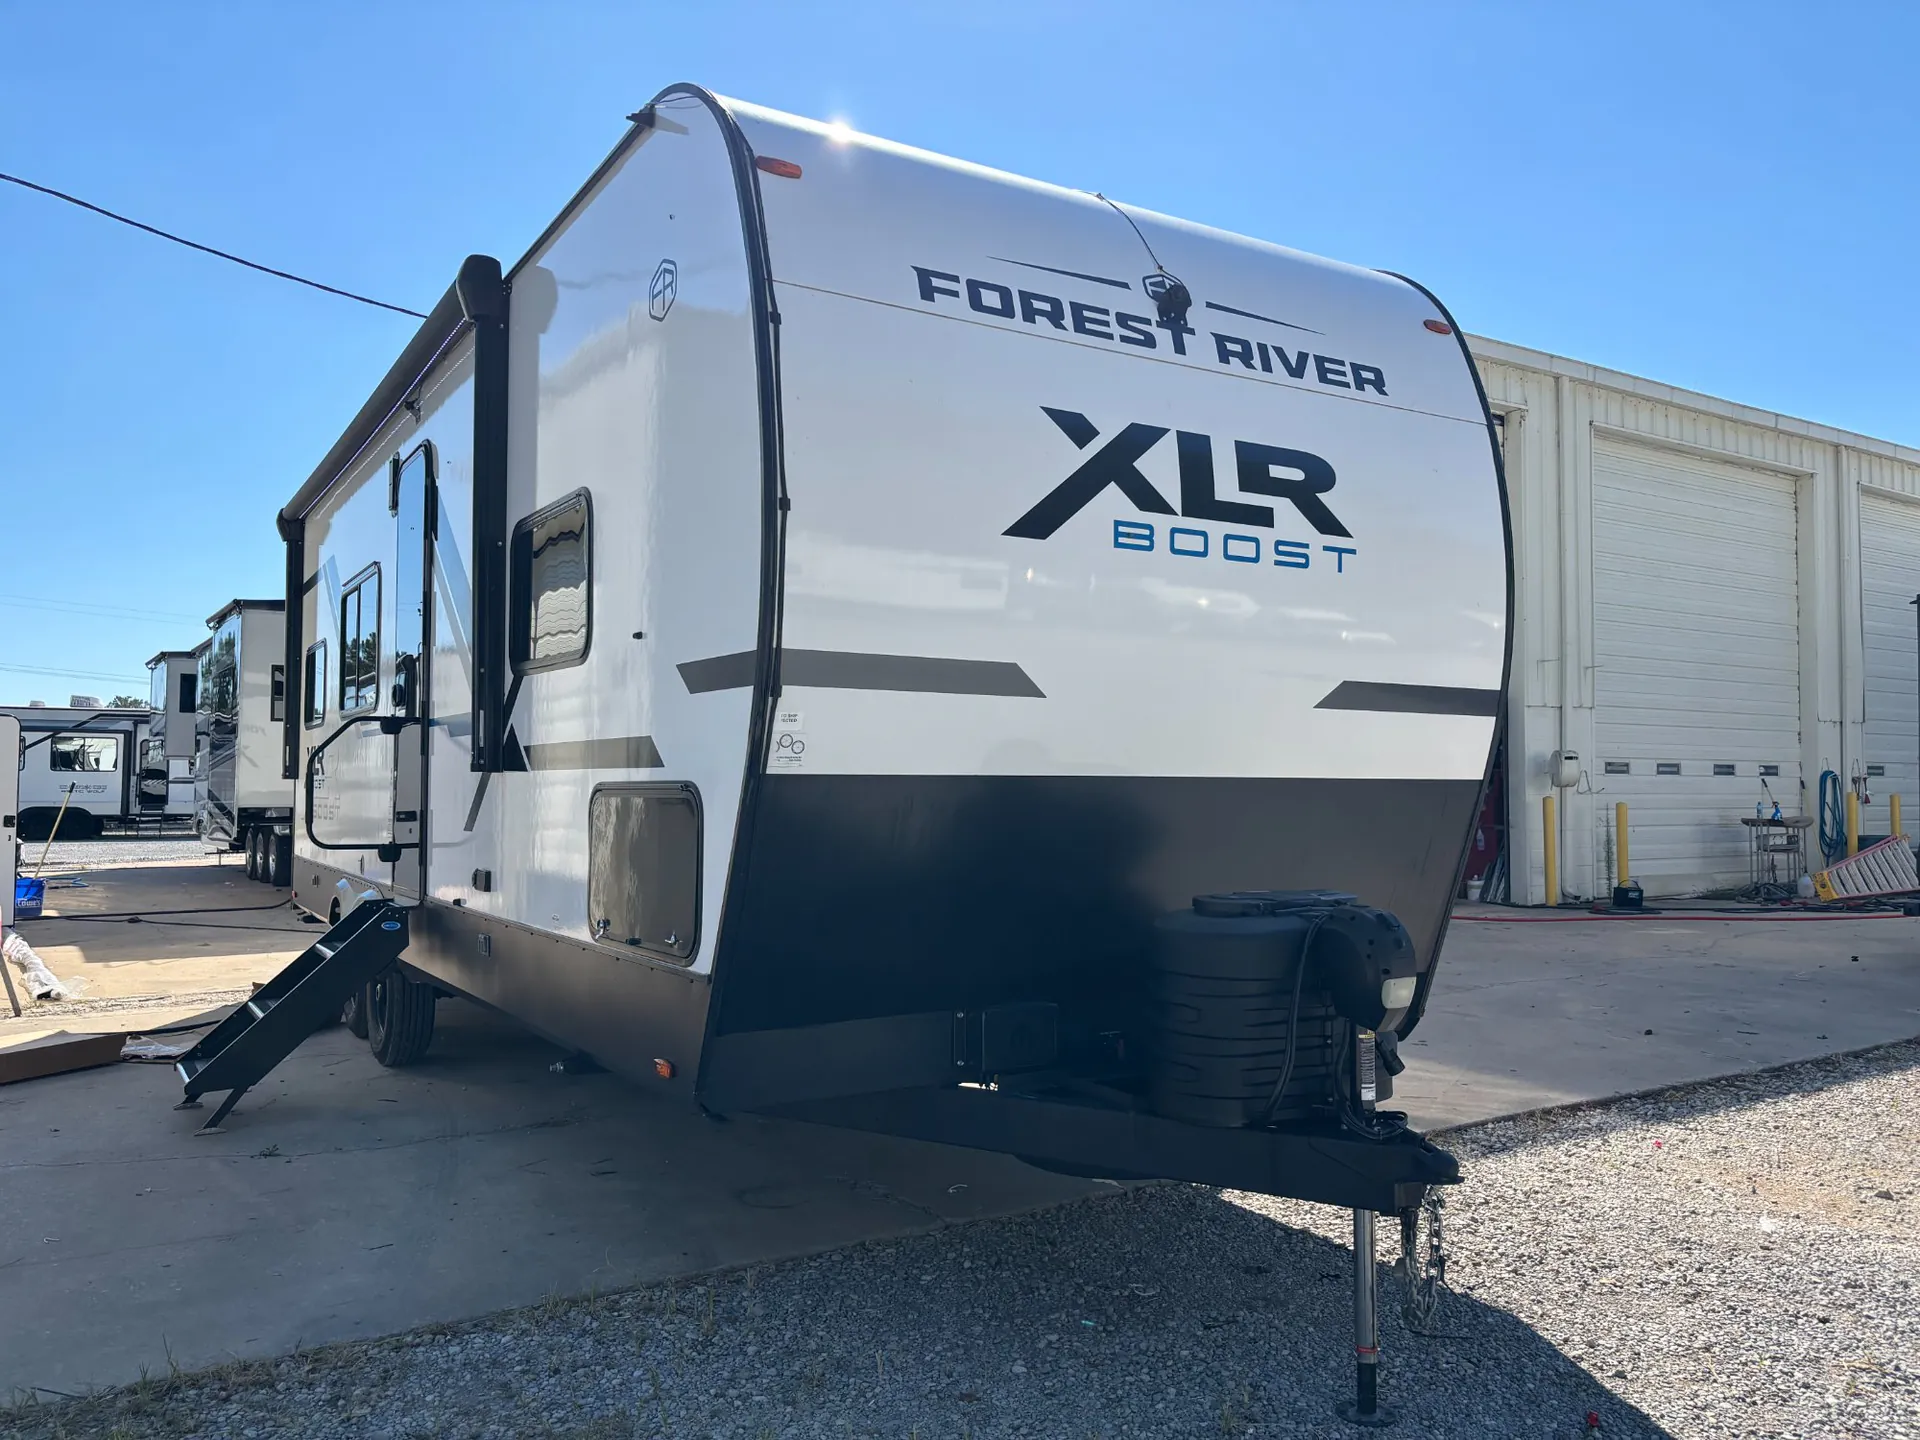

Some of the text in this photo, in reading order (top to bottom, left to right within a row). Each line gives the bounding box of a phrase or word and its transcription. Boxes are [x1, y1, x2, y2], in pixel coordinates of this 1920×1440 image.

[910, 265, 1390, 397] FOREST RIVER
[1000, 405, 1355, 541] XLR
[1113, 519, 1357, 574] BOOST
